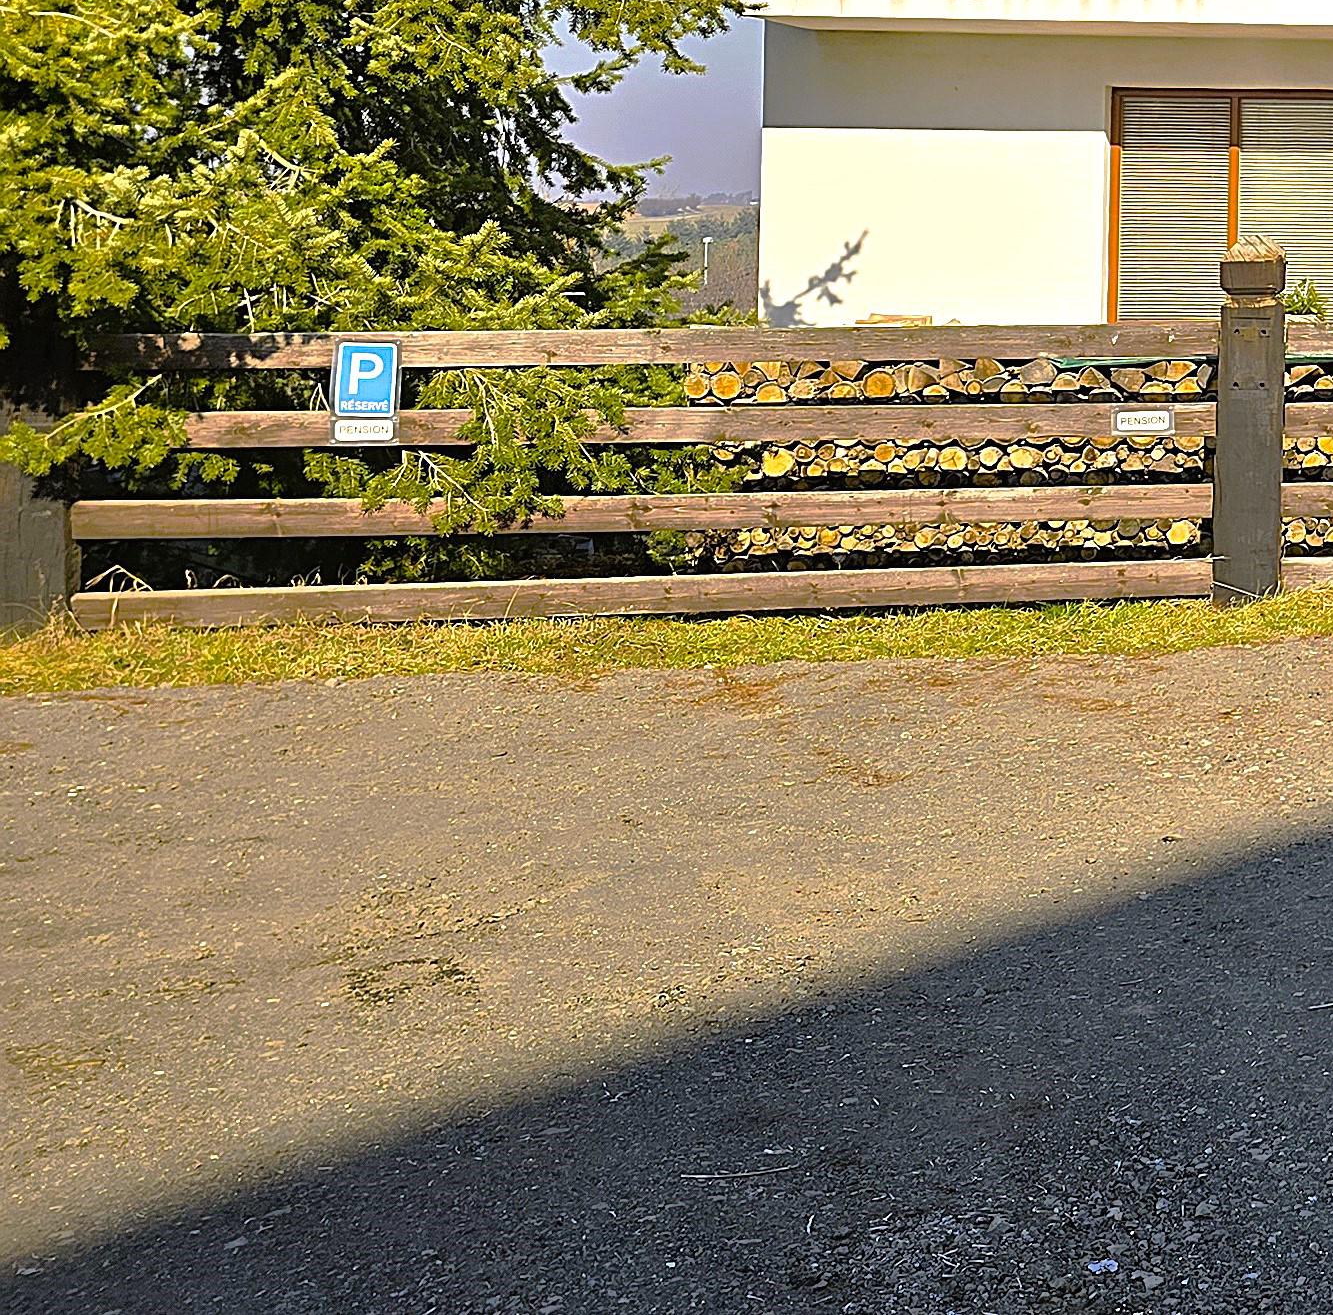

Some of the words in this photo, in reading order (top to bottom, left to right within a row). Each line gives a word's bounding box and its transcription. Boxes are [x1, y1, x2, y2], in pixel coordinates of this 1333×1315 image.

[348, 352, 385, 395] P
[340, 398, 389, 412] RÉSERVÉ
[1120, 416, 1166, 426] PENSION
[339, 425, 389, 435] PENSION
